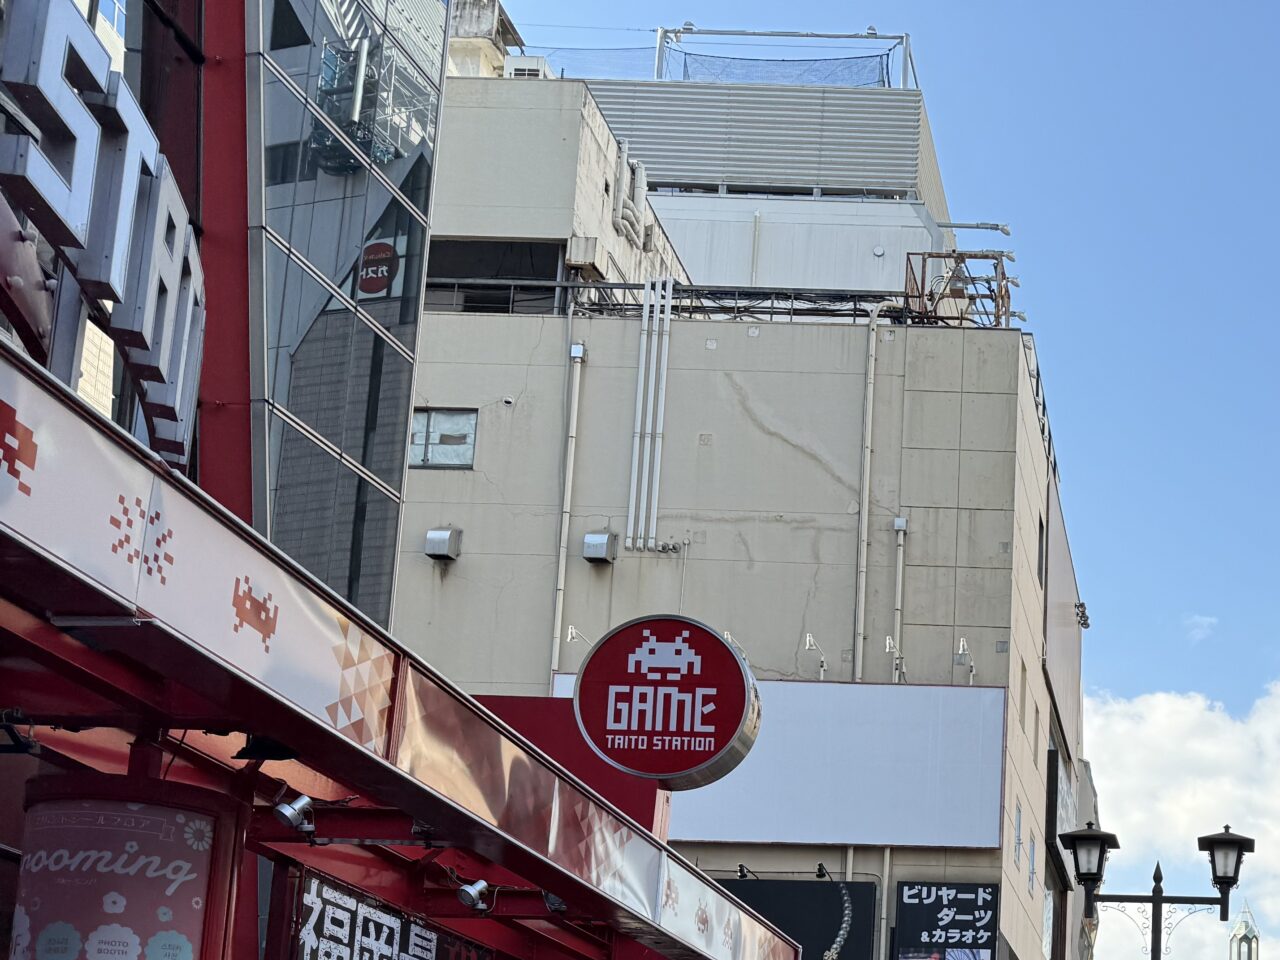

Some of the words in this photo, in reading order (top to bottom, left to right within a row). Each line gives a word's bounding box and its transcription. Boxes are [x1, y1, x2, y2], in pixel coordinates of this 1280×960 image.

[606, 685, 717, 732] GAME
[606, 735, 647, 749] TAITO
[653, 736, 715, 751] STATION
[903, 885, 993, 906] ビリヤード
[937, 907, 993, 927] ダーツ
